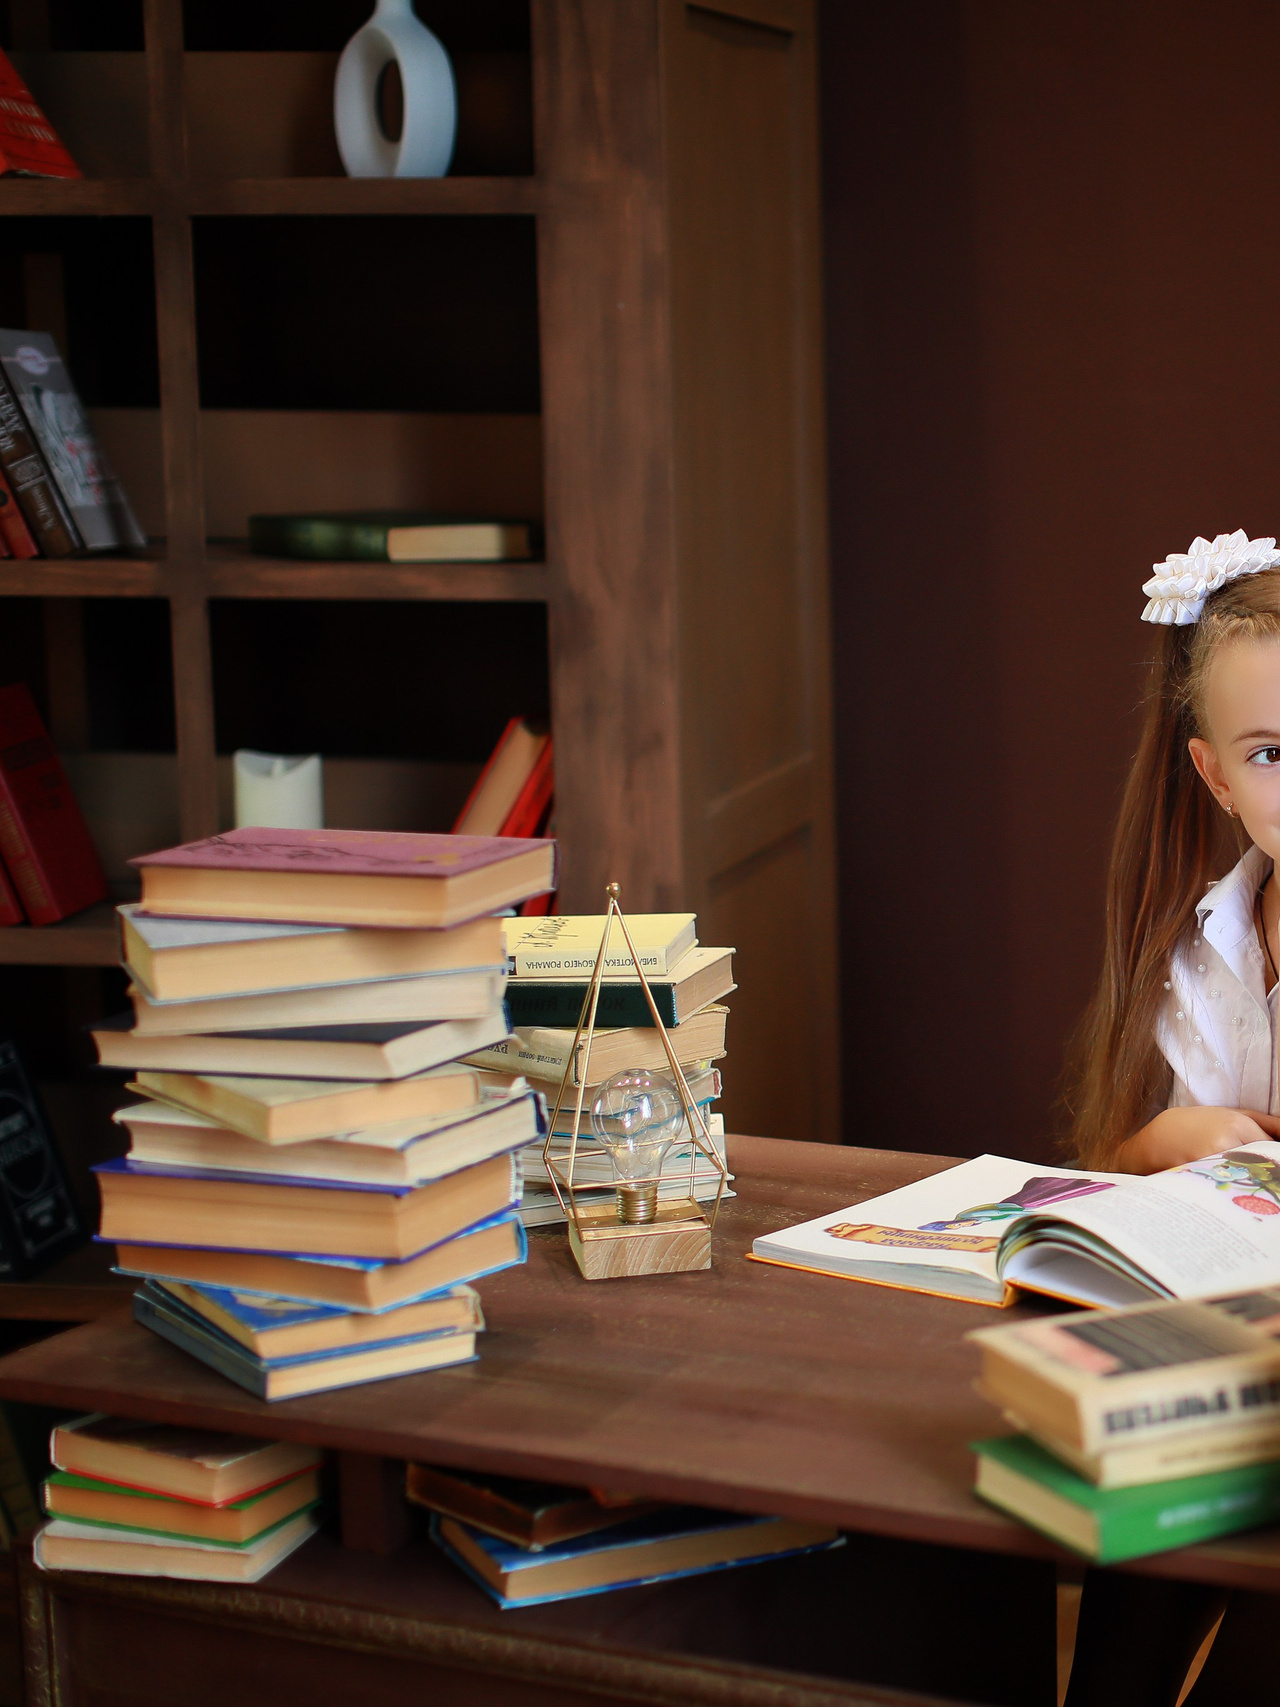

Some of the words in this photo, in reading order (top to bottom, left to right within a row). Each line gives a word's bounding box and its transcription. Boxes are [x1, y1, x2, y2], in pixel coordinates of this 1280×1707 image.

[525, 960, 561, 969] РОМАНА
[564, 959, 598, 968] АБОЧЕГО
[604, 957, 657, 967] БИБИОТЕКА
